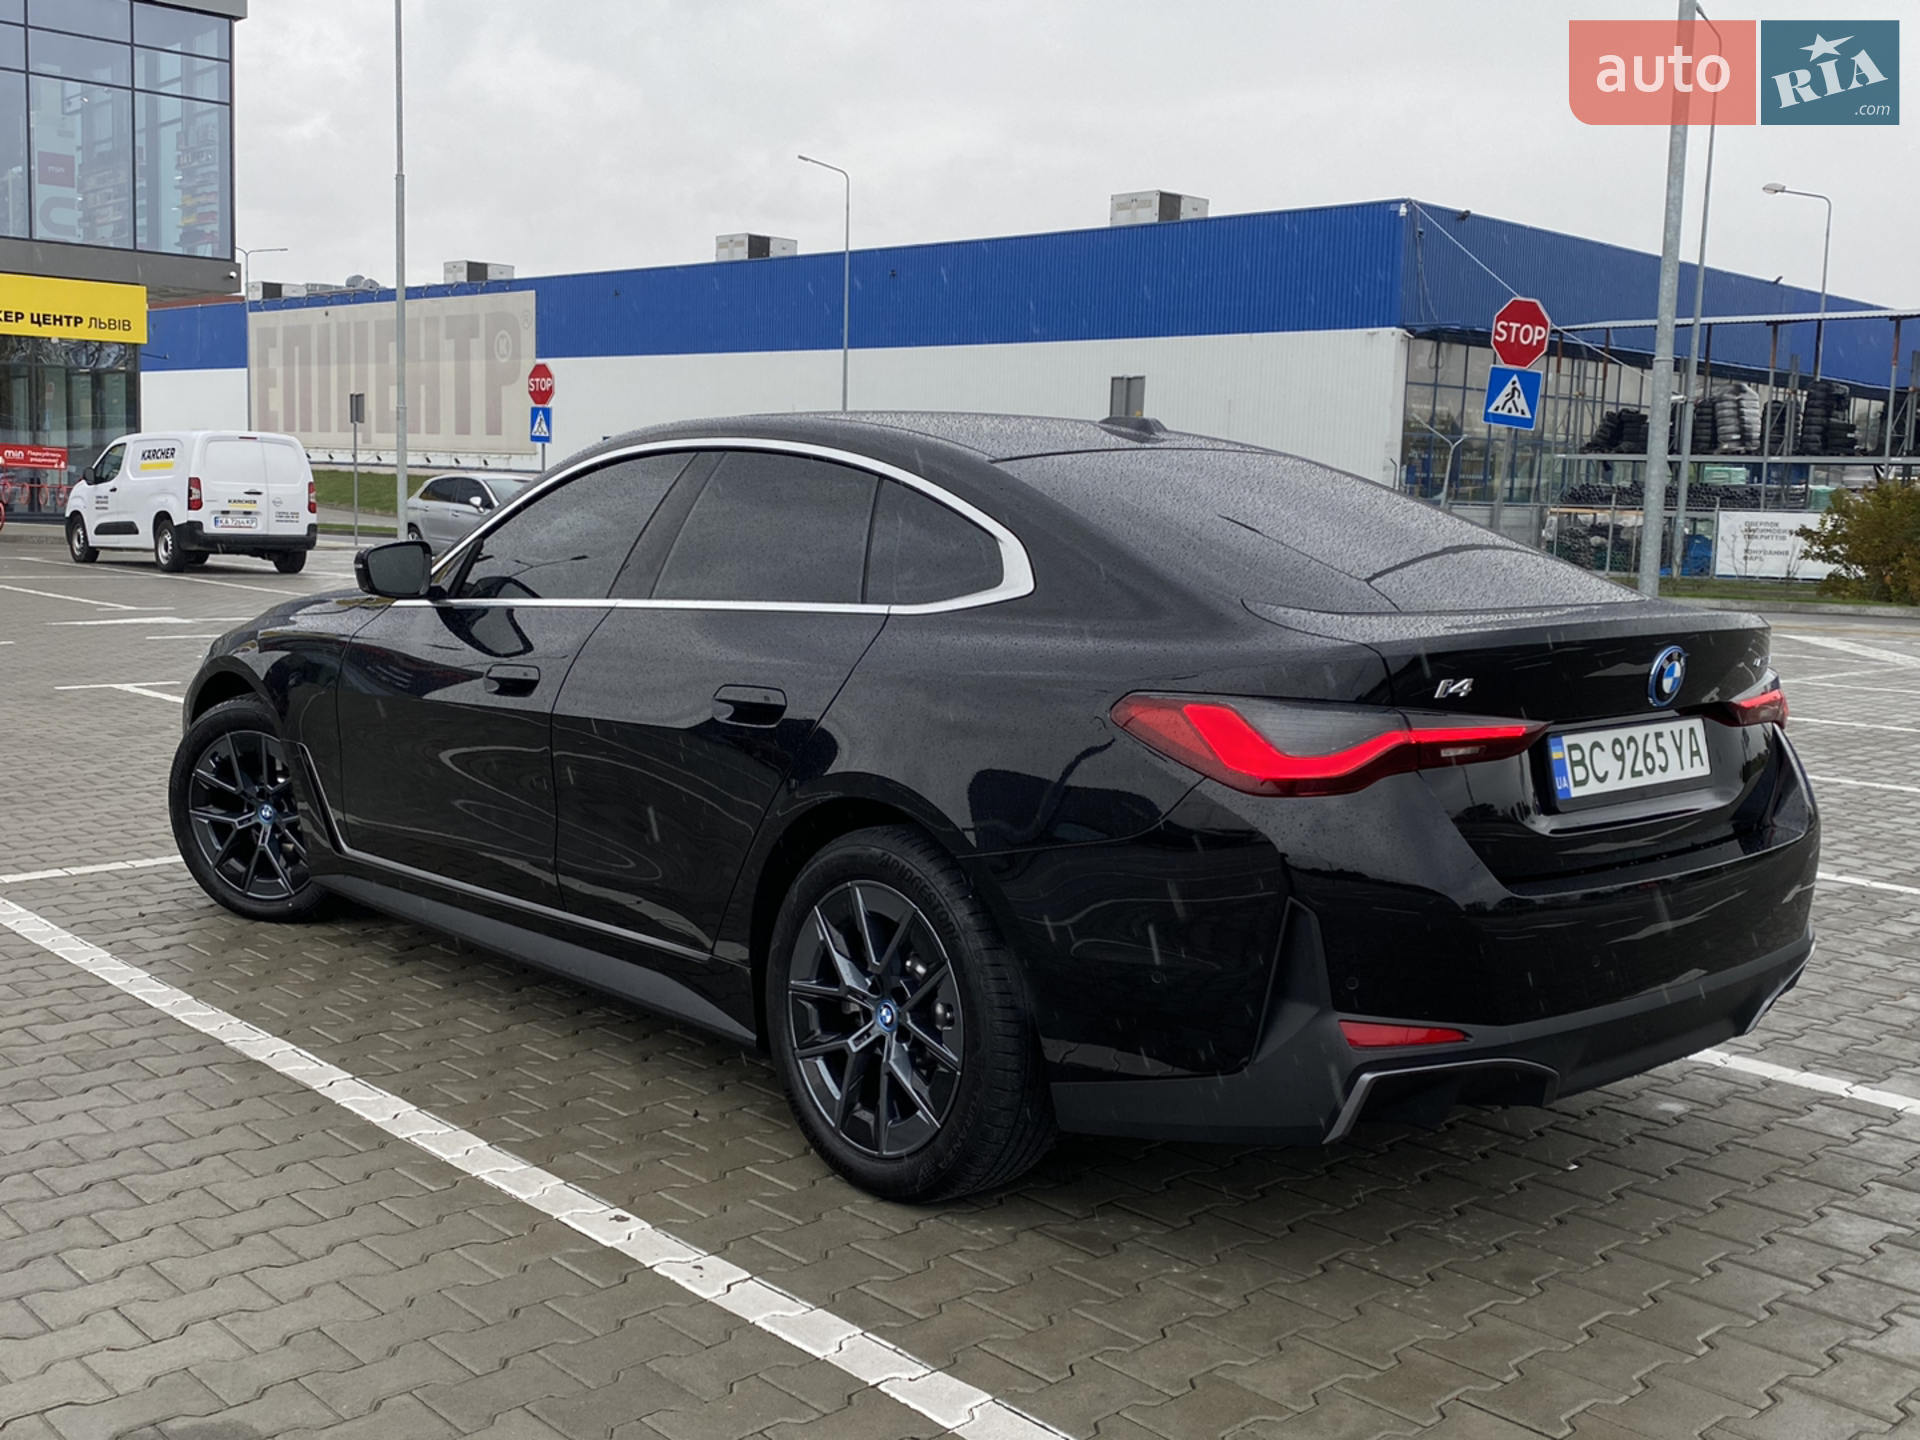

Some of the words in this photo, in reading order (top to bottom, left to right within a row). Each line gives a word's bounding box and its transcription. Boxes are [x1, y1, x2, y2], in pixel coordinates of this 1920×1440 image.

[0, 310, 25, 323] ЕР
[30, 312, 84, 327] ЦЕНТР
[88, 316, 132, 331] ЛЬВІВ
[1494, 320, 1546, 346] STOP
[528, 377, 553, 392] STOP
[4, 449, 25, 460] min
[1566, 740, 1609, 788] BC
[1611, 731, 1669, 781] 9265
[1670, 726, 1705, 771] YA
[1555, 776, 1569, 790] UA
